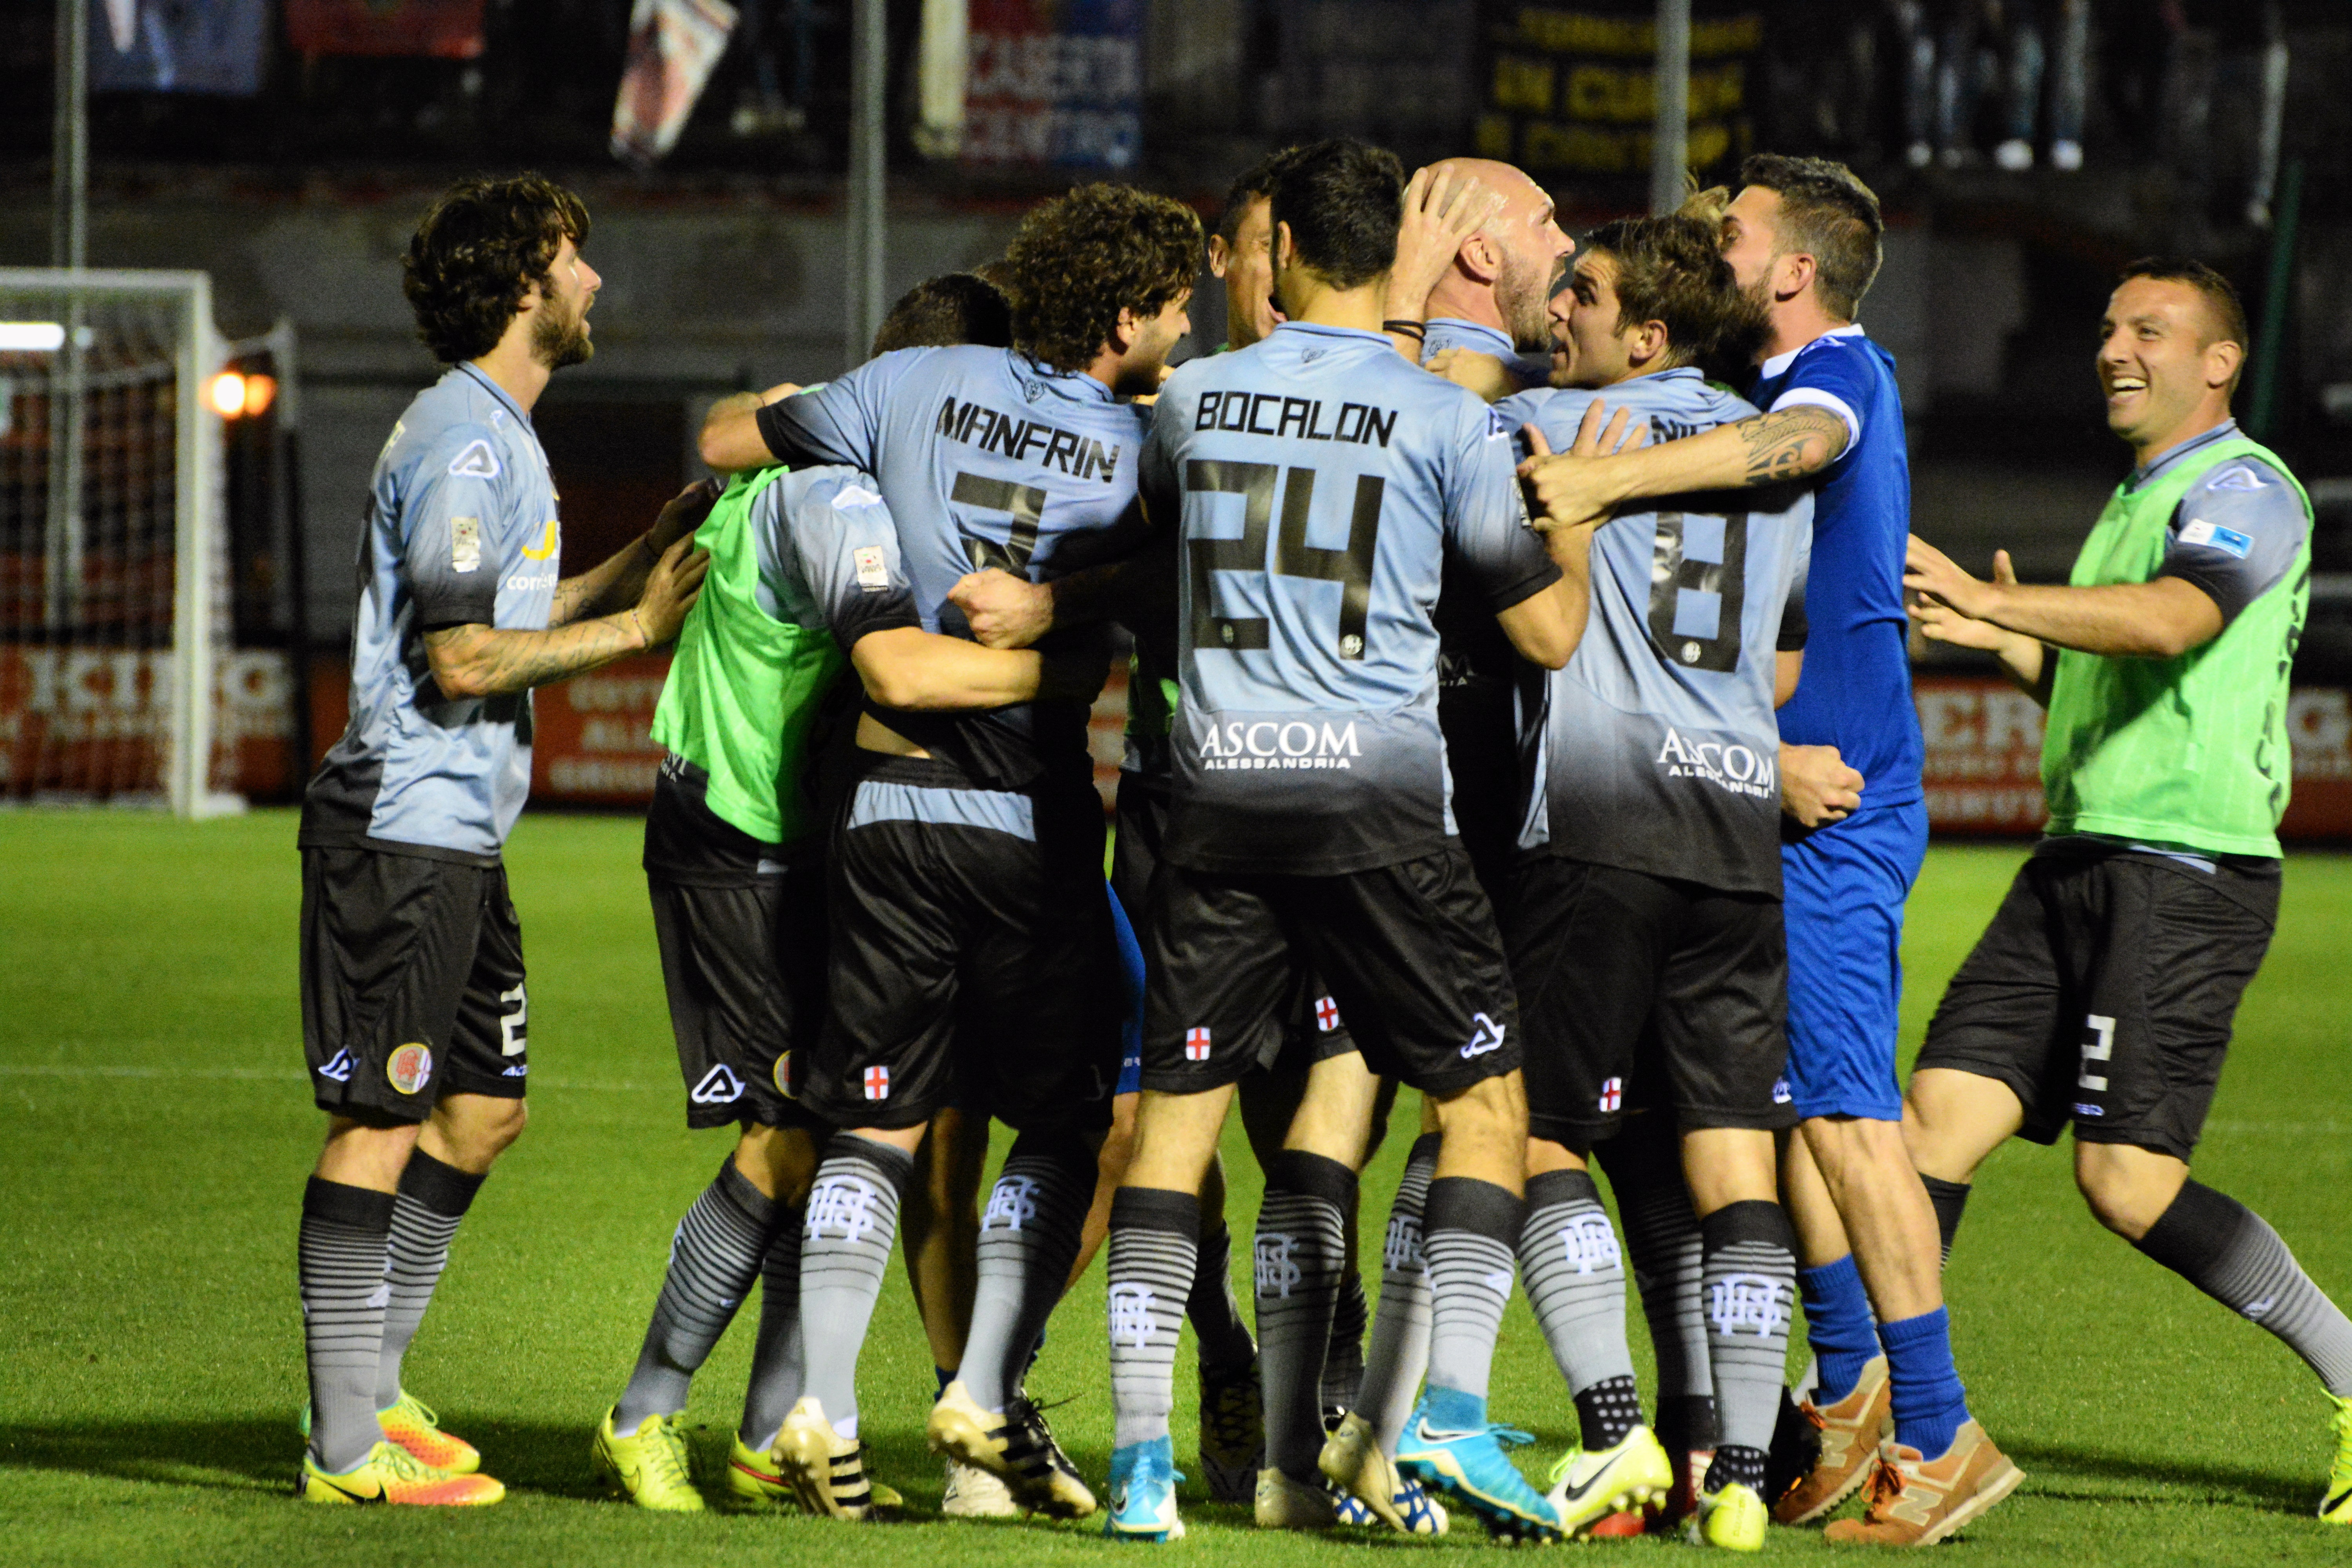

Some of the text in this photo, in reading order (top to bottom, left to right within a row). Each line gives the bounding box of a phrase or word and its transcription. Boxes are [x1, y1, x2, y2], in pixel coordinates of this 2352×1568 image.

[935, 396, 1120, 483] MANFRIN
[1195, 391, 1398, 448] BOCALON
[1187, 459, 1386, 660] 24
[1648, 512, 1749, 673] 8
[1200, 720, 1362, 758] ASCOM
[1204, 757, 1351, 770] ALESSANDRIA
[2078, 1014, 2116, 1091] 2
